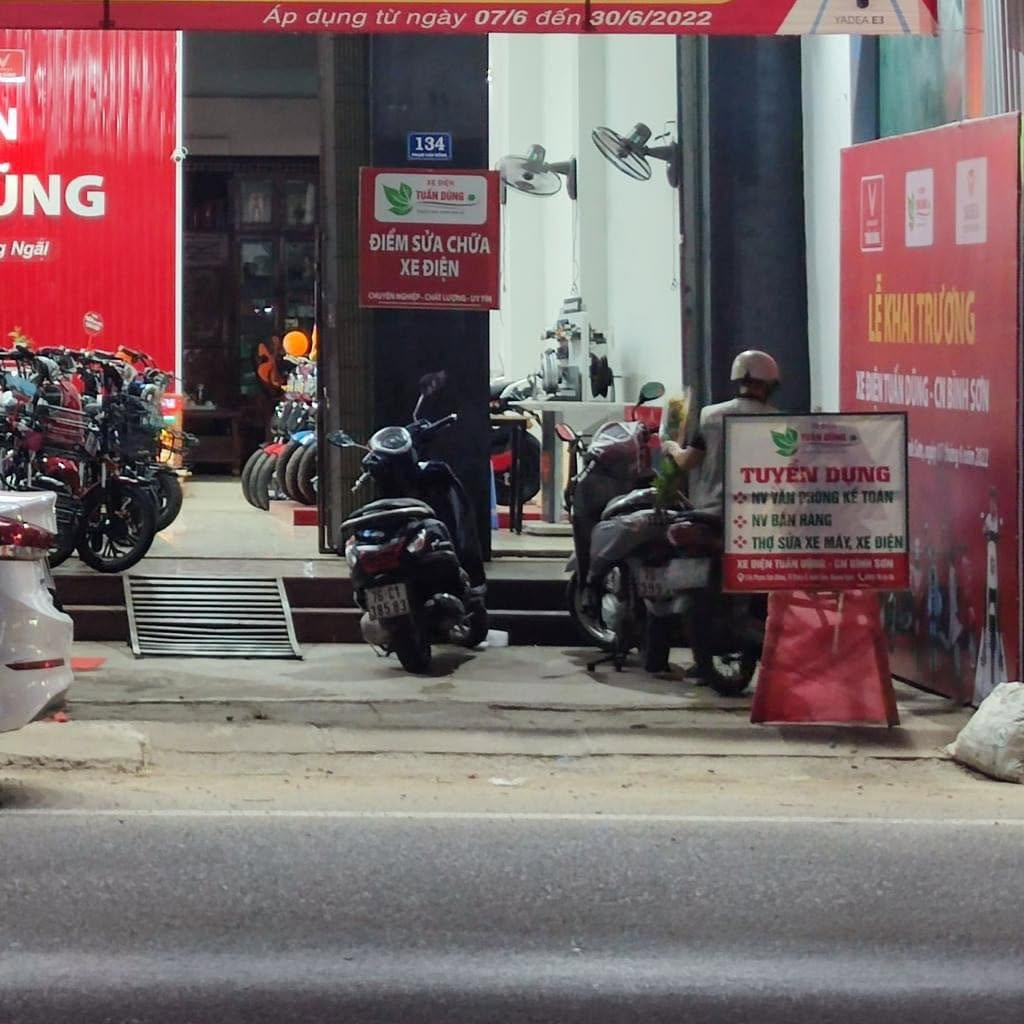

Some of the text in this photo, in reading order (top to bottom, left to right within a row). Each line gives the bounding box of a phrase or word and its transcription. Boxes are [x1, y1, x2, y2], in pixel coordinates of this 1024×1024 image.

[263, 4, 712, 29] Áp dụng từ ngày 07/6 đến 30/6/2022
[415, 136, 445, 152] 134
[369, 228, 490, 254] ĐIỂM SỬA CHỮA
[400, 256, 459, 283] XE ĐIỆN
[884, 292, 915, 344] KHAI
[916, 283, 976, 345] TRƯƠNG
[740, 459, 891, 487] TUYỂN DỤNG
[752, 514, 768, 527] NV
[752, 536, 775, 551] THỢ
[805, 536, 820, 550] XE
[856, 536, 870, 550] XE
[875, 533, 904, 552] ĐIỆN
